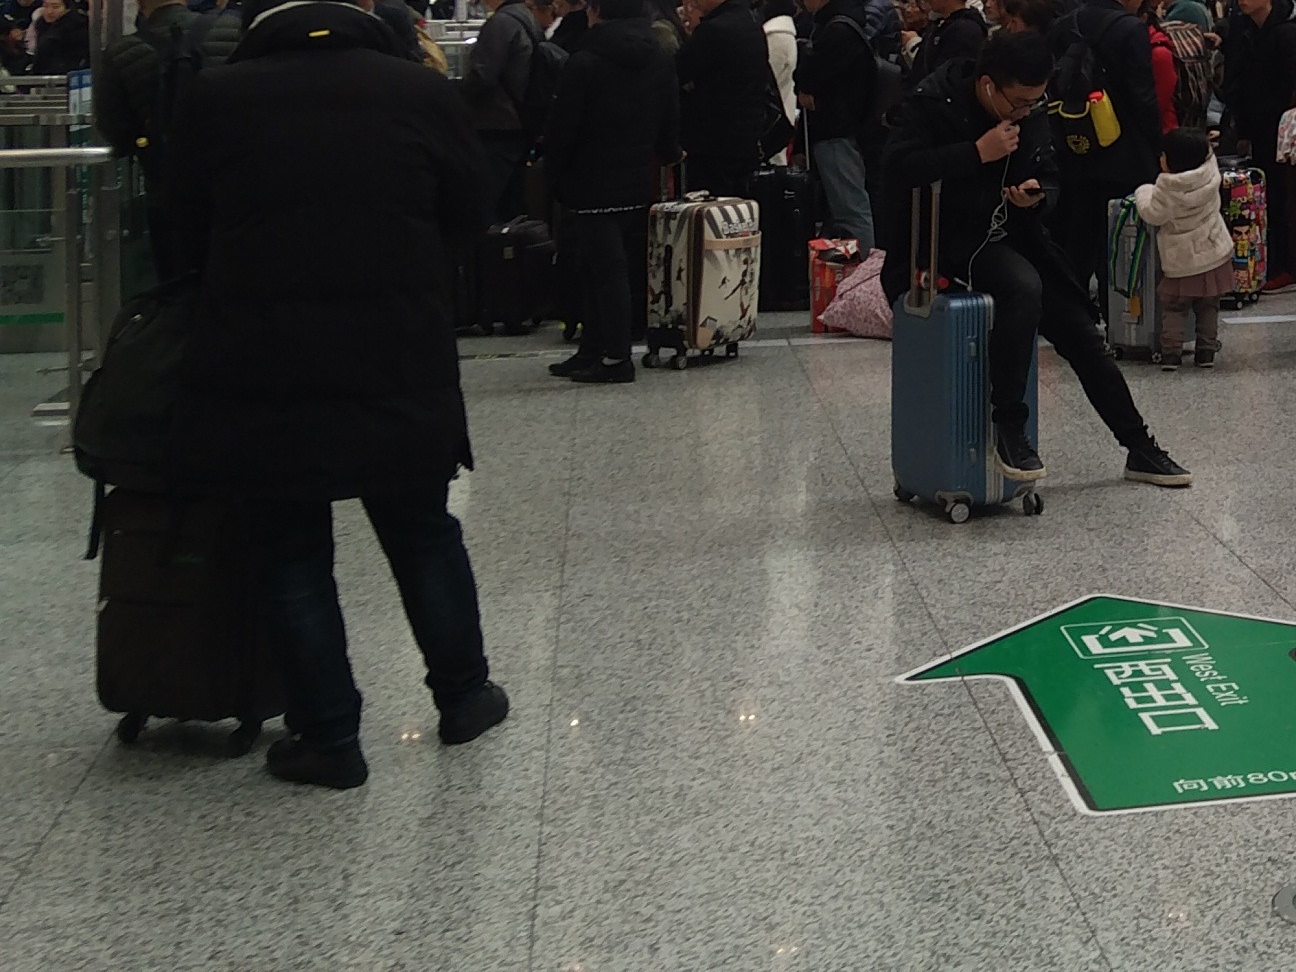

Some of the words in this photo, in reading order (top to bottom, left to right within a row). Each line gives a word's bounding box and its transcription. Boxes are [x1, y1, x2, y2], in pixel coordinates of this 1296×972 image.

[1093, 658, 1219, 735] 西出口
[1181, 652, 1227, 682] West
[1206, 682, 1250, 706] Exit
